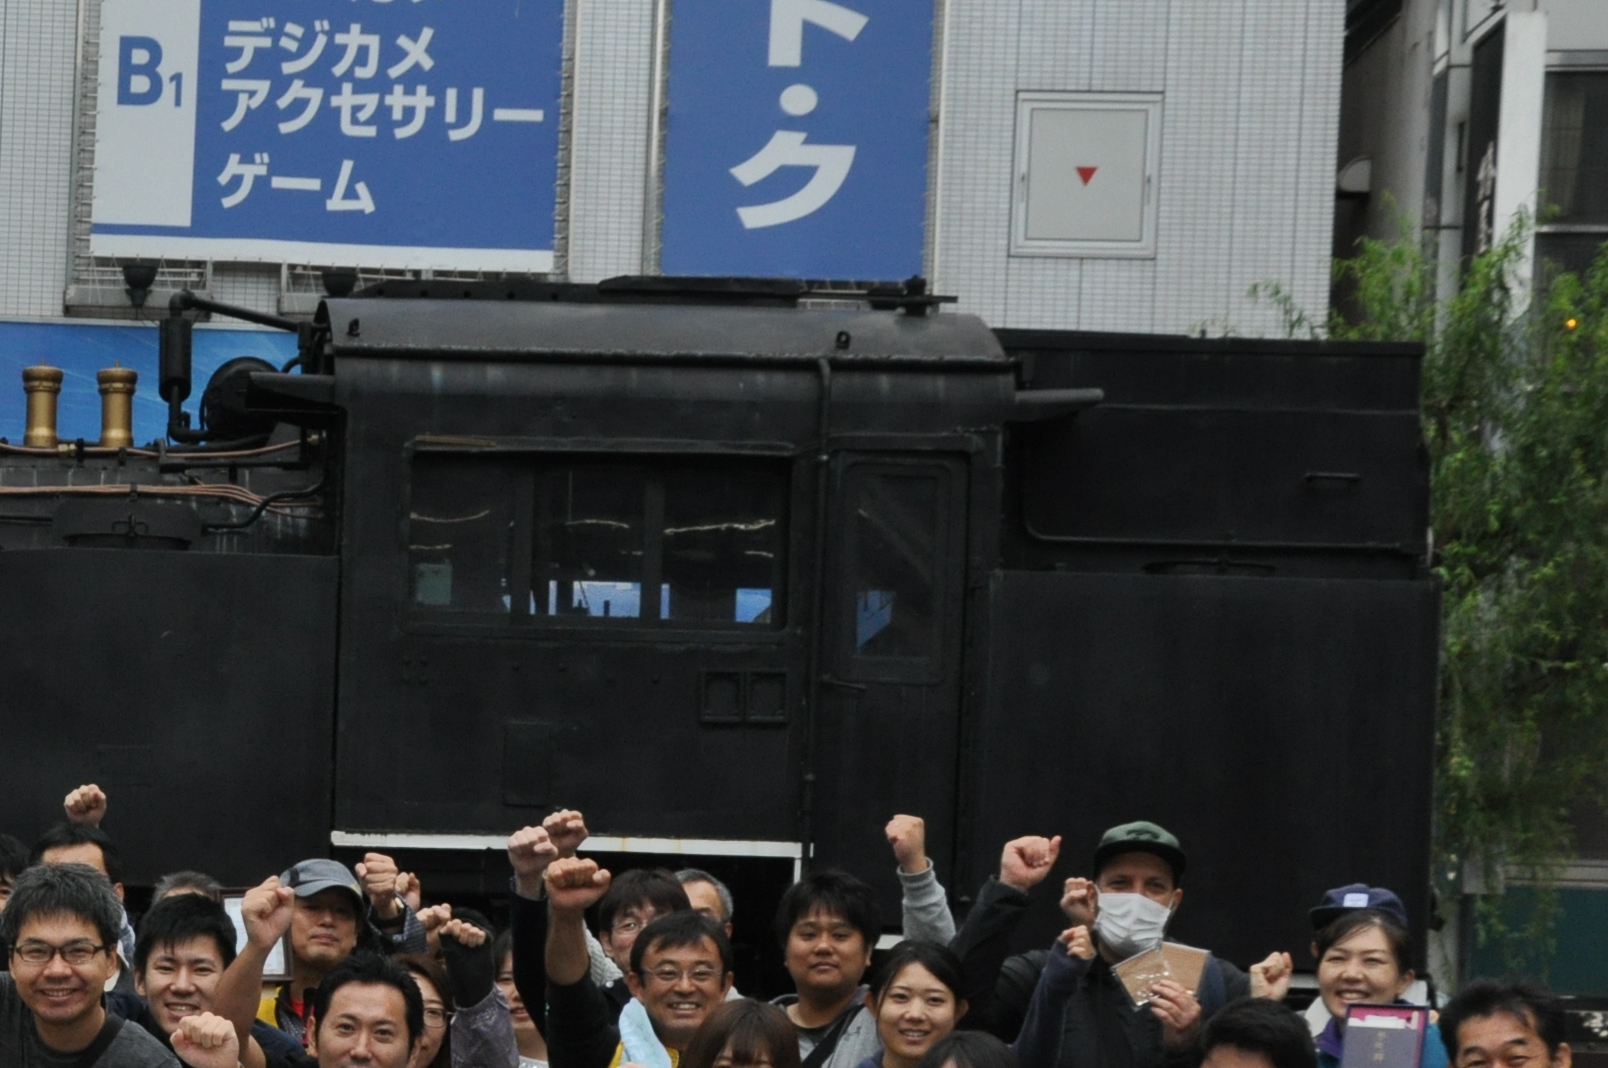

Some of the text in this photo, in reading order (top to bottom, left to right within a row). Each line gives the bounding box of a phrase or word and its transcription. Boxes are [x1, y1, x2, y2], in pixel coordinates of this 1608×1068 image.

[116, 35, 184, 108] B1
[223, 17, 435, 79] デジカメ
[220, 79, 545, 141] アクセサリー
[216, 152, 376, 214] ゲーム
